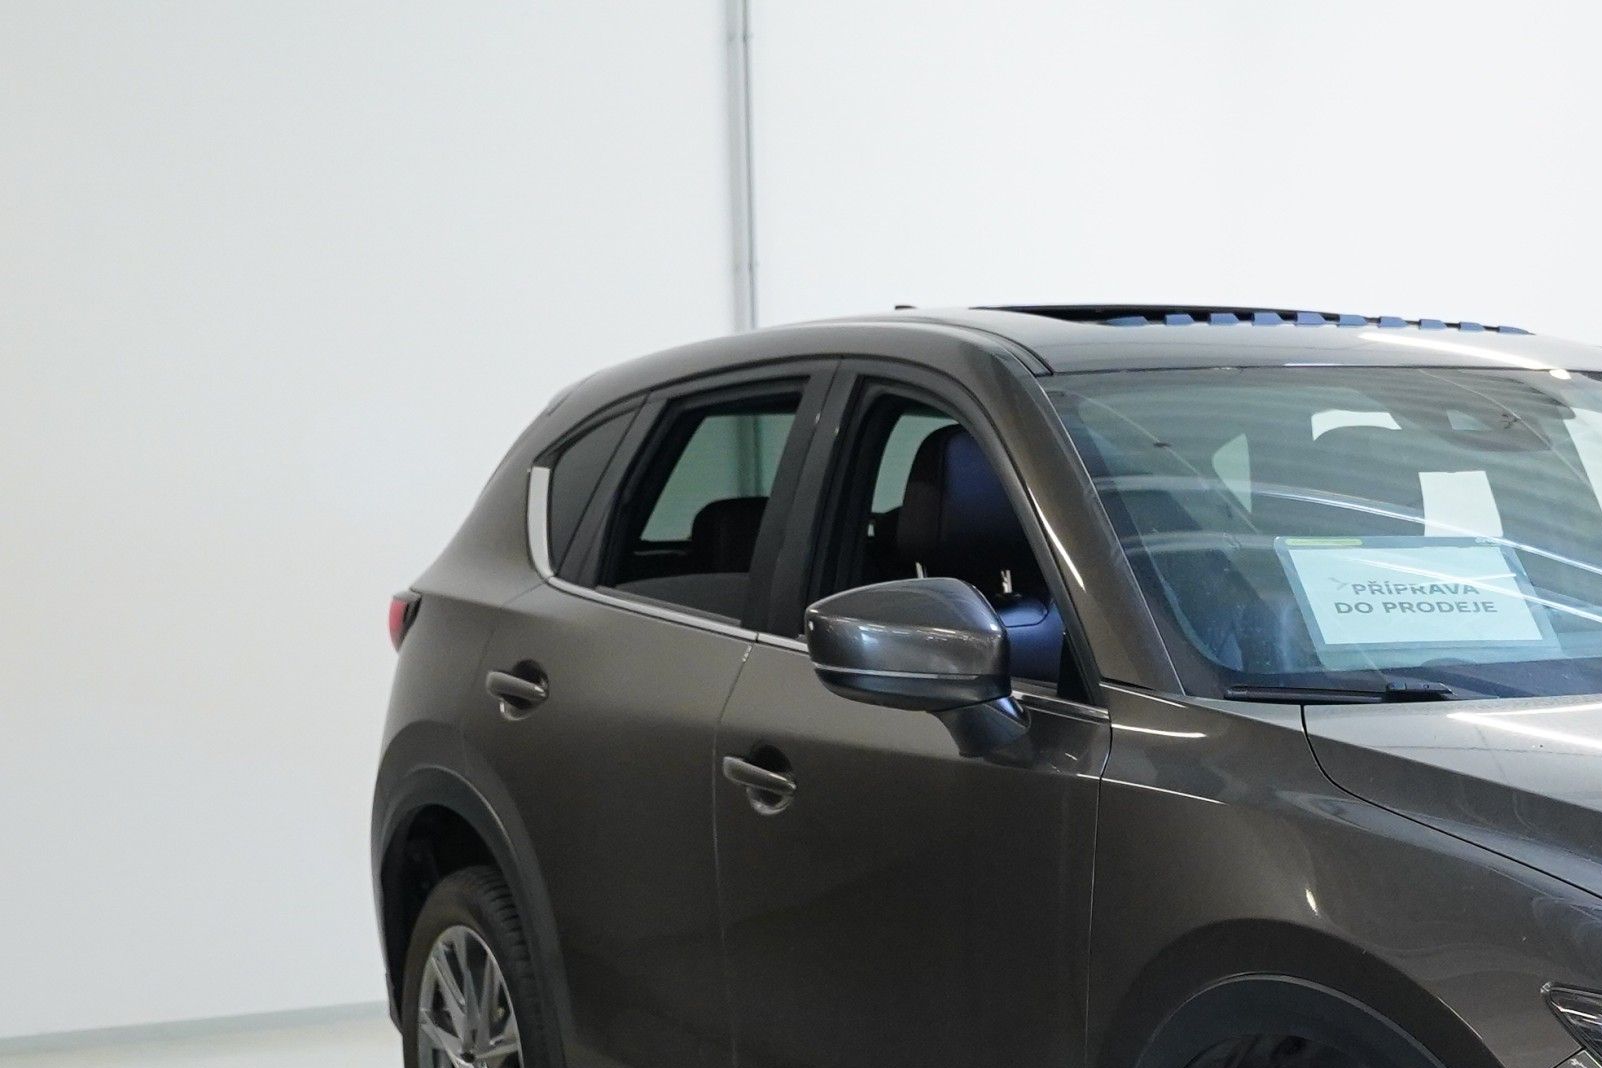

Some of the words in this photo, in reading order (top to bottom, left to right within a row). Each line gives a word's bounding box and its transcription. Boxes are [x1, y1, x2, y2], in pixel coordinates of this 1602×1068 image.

[1351, 579, 1480, 596] PŘÍPRAVA
[1333, 601, 1374, 614] DO
[1383, 601, 1498, 614] PRODEJE
